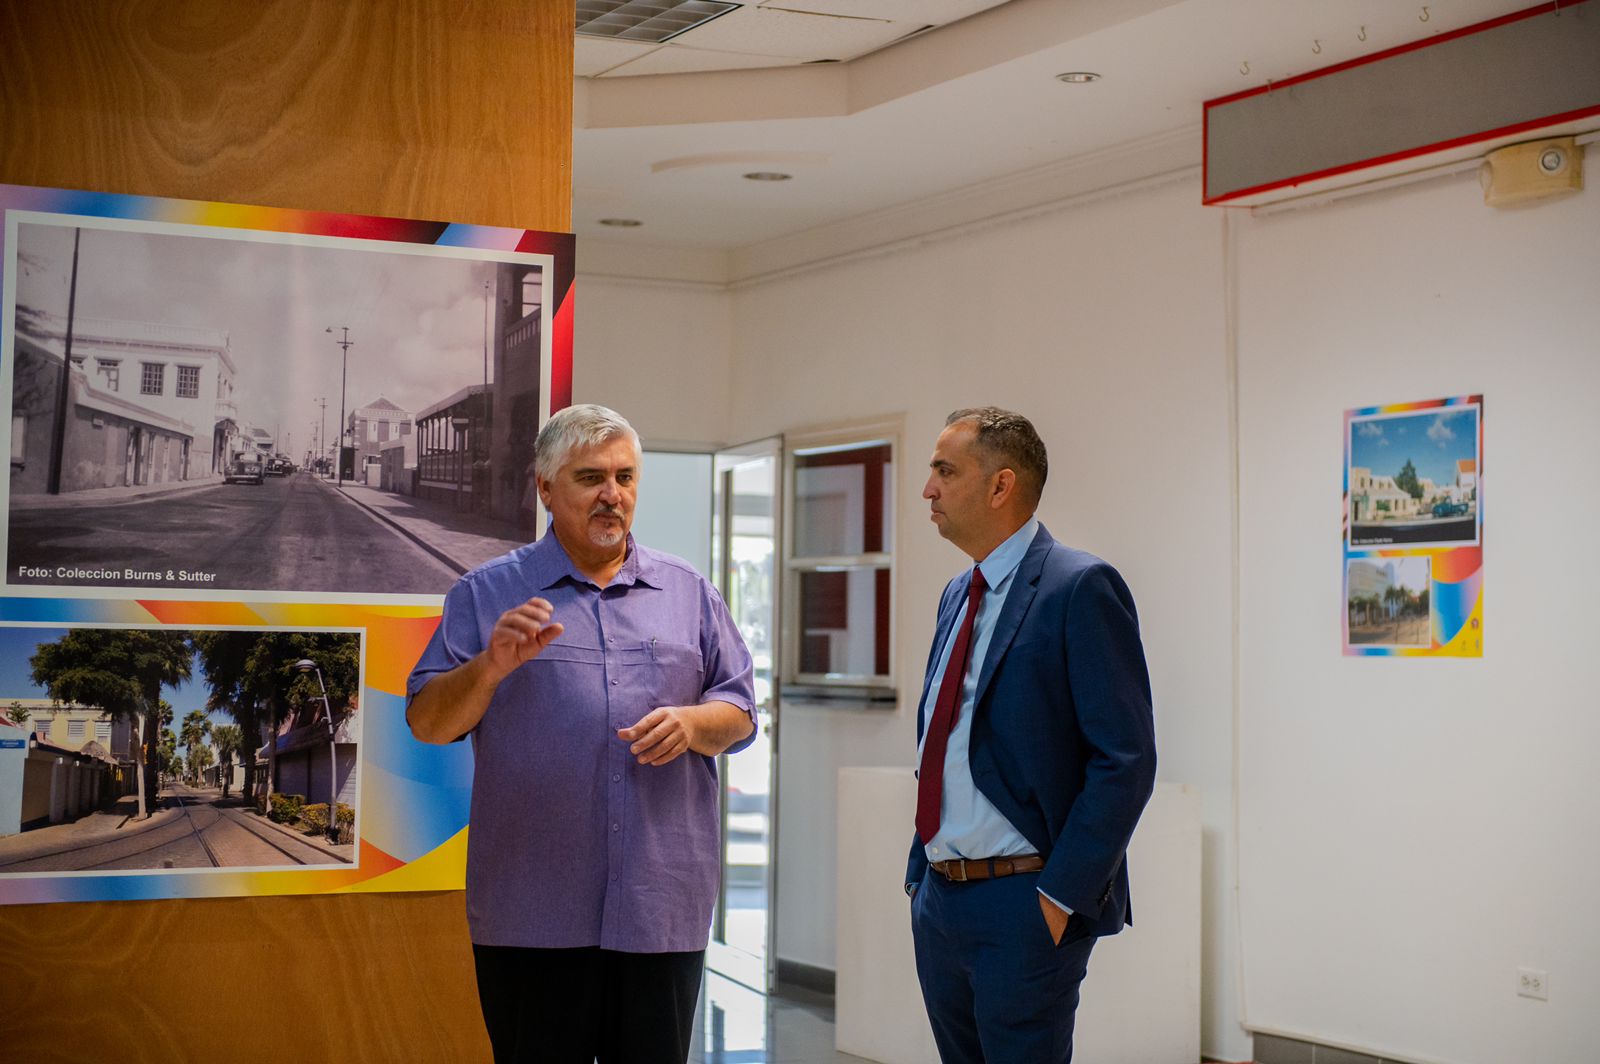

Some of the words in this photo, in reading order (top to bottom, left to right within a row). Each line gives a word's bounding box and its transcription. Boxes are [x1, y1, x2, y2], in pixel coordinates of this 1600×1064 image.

[18, 566, 52, 578] Foto:
[56, 567, 121, 580] Coleccion
[124, 568, 162, 581] Burns
[165, 570, 175, 581] &
[178, 570, 216, 582] Sutter
